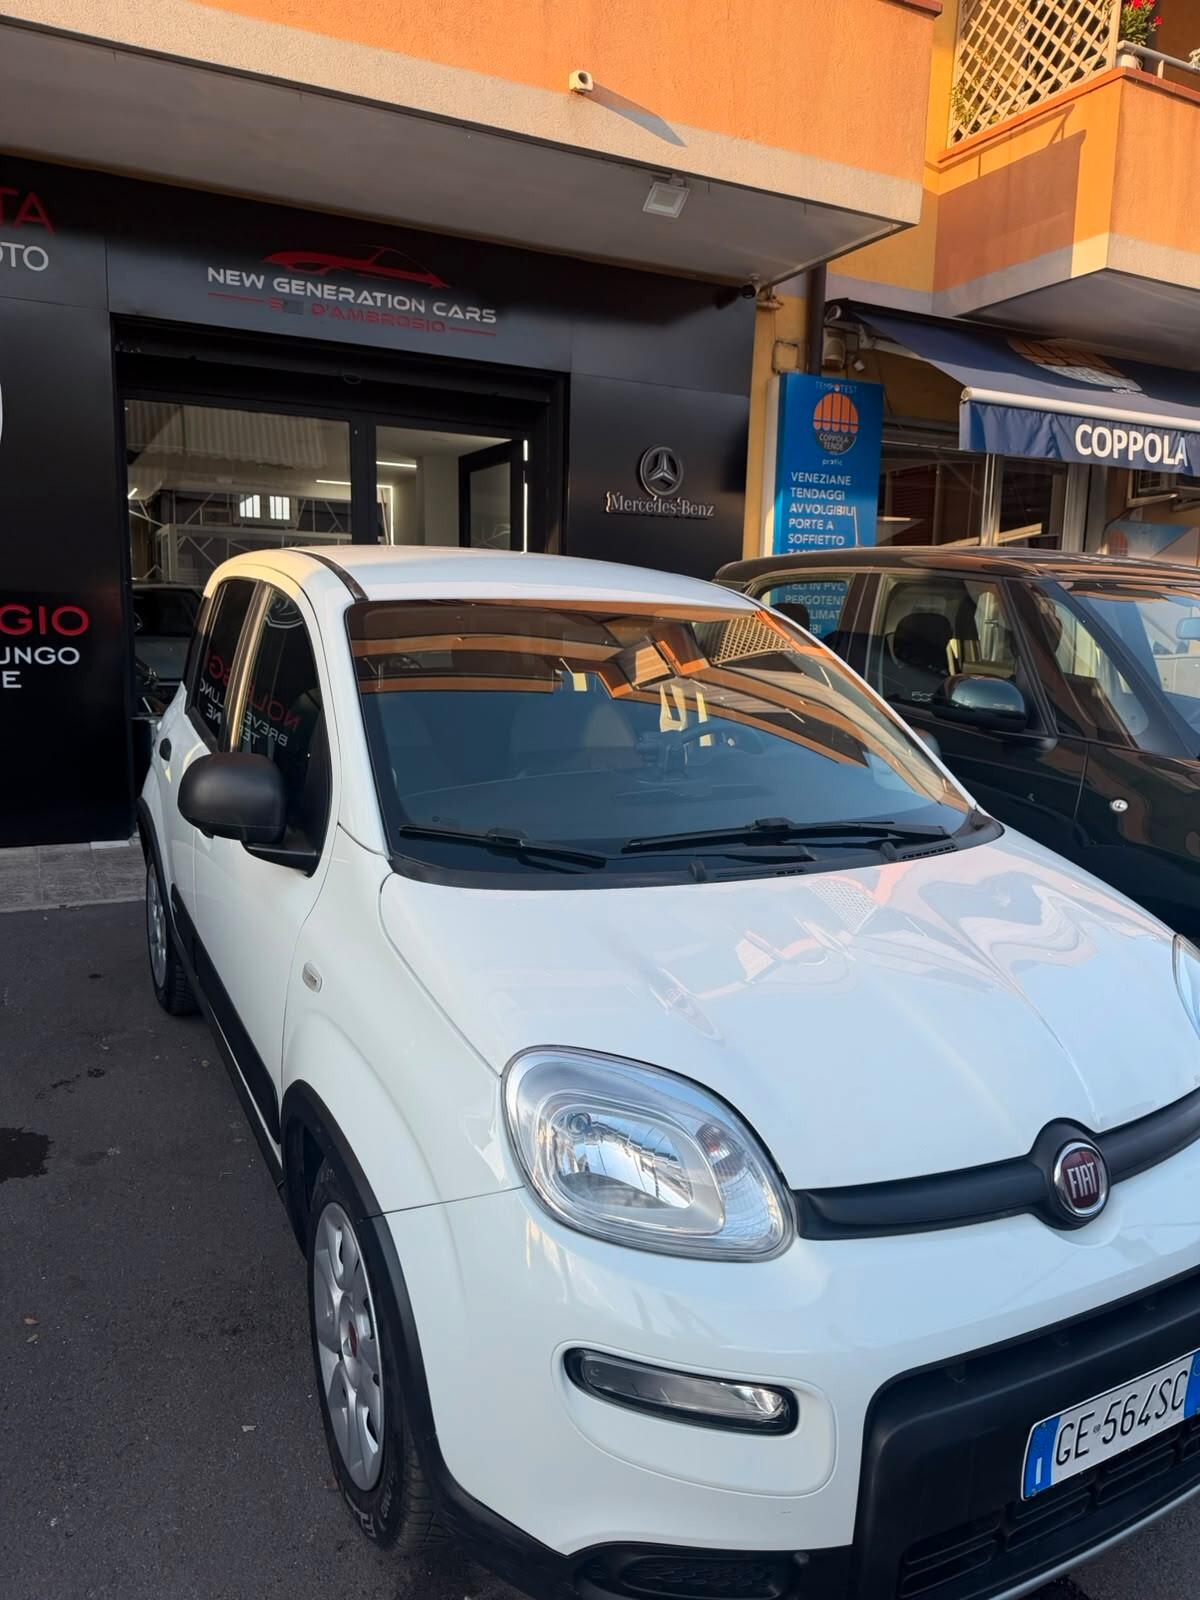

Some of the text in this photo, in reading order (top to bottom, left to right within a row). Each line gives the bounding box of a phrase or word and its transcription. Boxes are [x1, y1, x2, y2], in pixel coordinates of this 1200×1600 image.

[0, 241, 49, 272] TO
[207, 266, 264, 290] NEW
[272, 277, 425, 313] GENERATION
[432, 300, 497, 324] CARS
[311, 303, 446, 333] D'AMBROSIO
[1075, 423, 1188, 467] COPPOLA
[790, 471, 852, 486] VENEZIANE
[605, 490, 715, 517] Mercedes-Benz
[789, 487, 845, 501] TENDAGGI
[787, 533, 845, 546] SOFFIETTO
[788, 518, 834, 531] PORTE A
[1066, 1161, 1100, 1200] FIAT
[1055, 1369, 1188, 1466] GE 564SC
